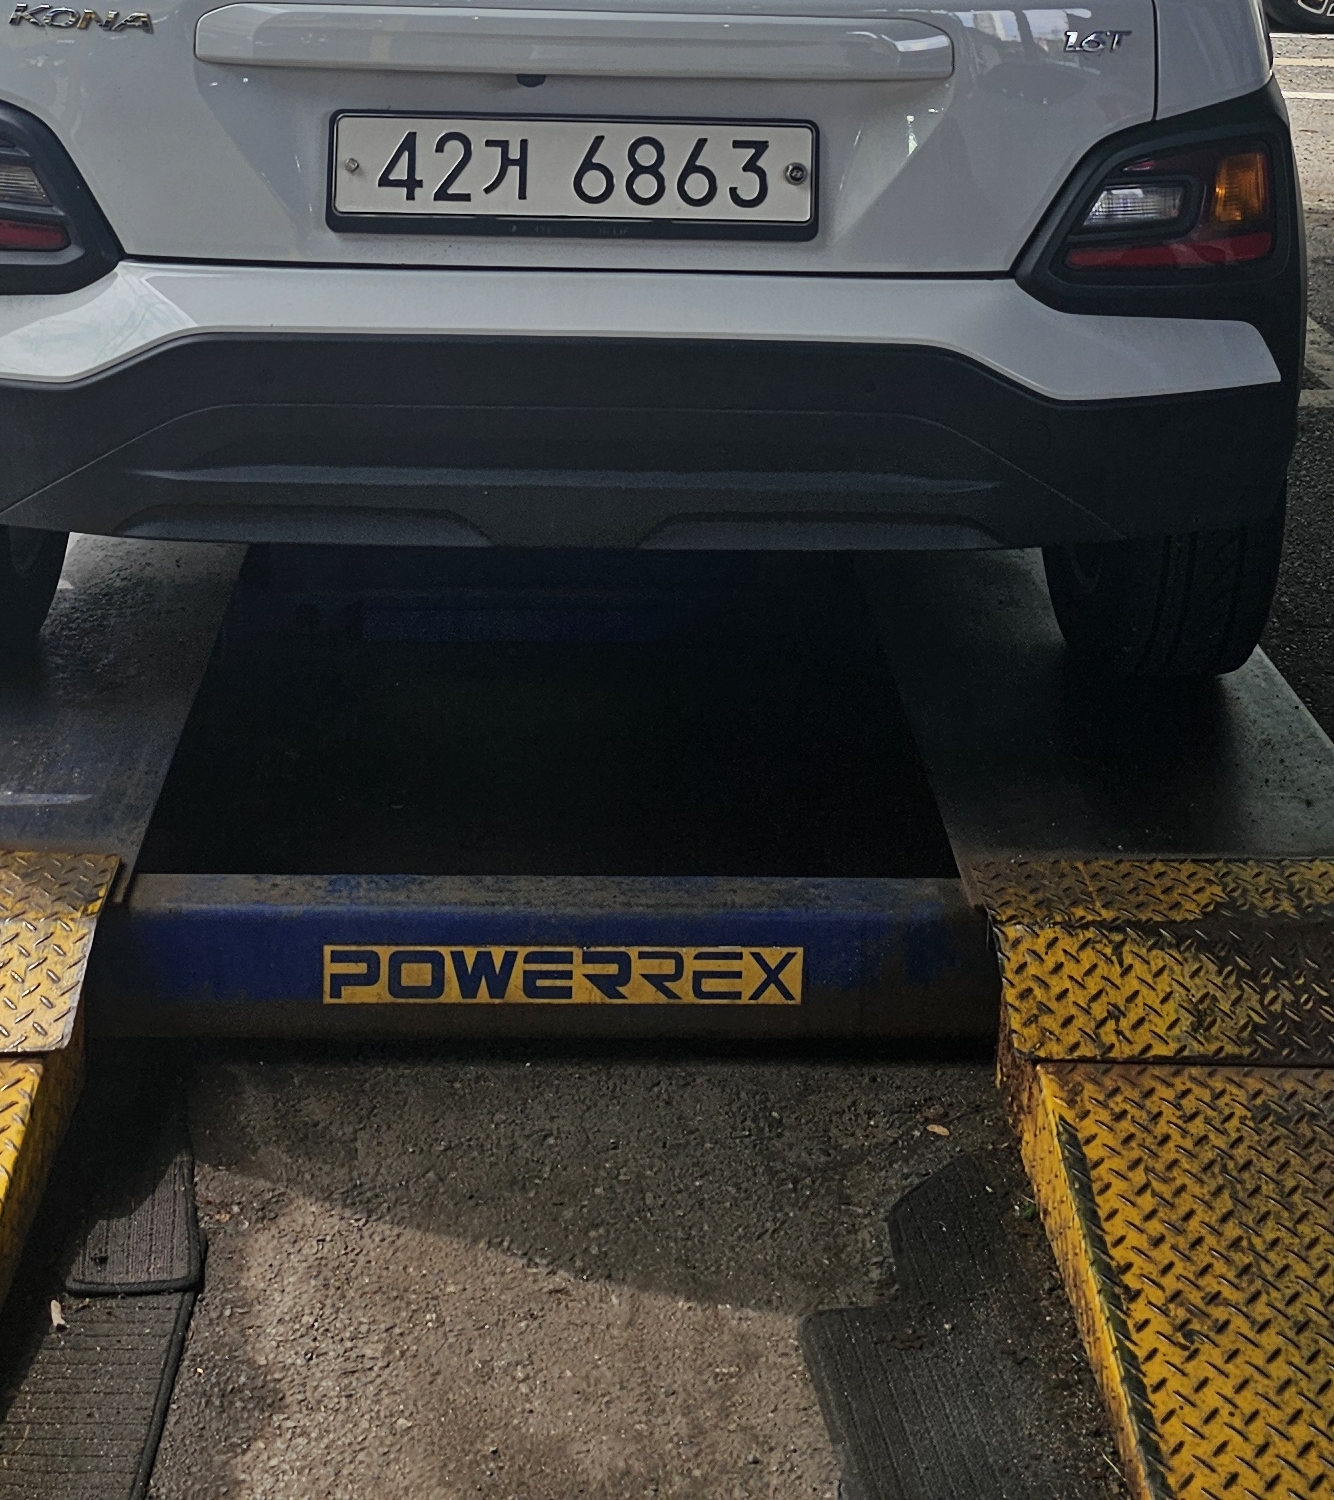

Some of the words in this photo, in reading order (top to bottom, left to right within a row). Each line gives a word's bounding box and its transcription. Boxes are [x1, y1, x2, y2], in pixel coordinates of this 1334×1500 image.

[8, 2, 155, 35] KONA
[378, 130, 529, 203] 42거
[573, 134, 770, 209] 6863
[328, 949, 799, 1001] POWERREX
